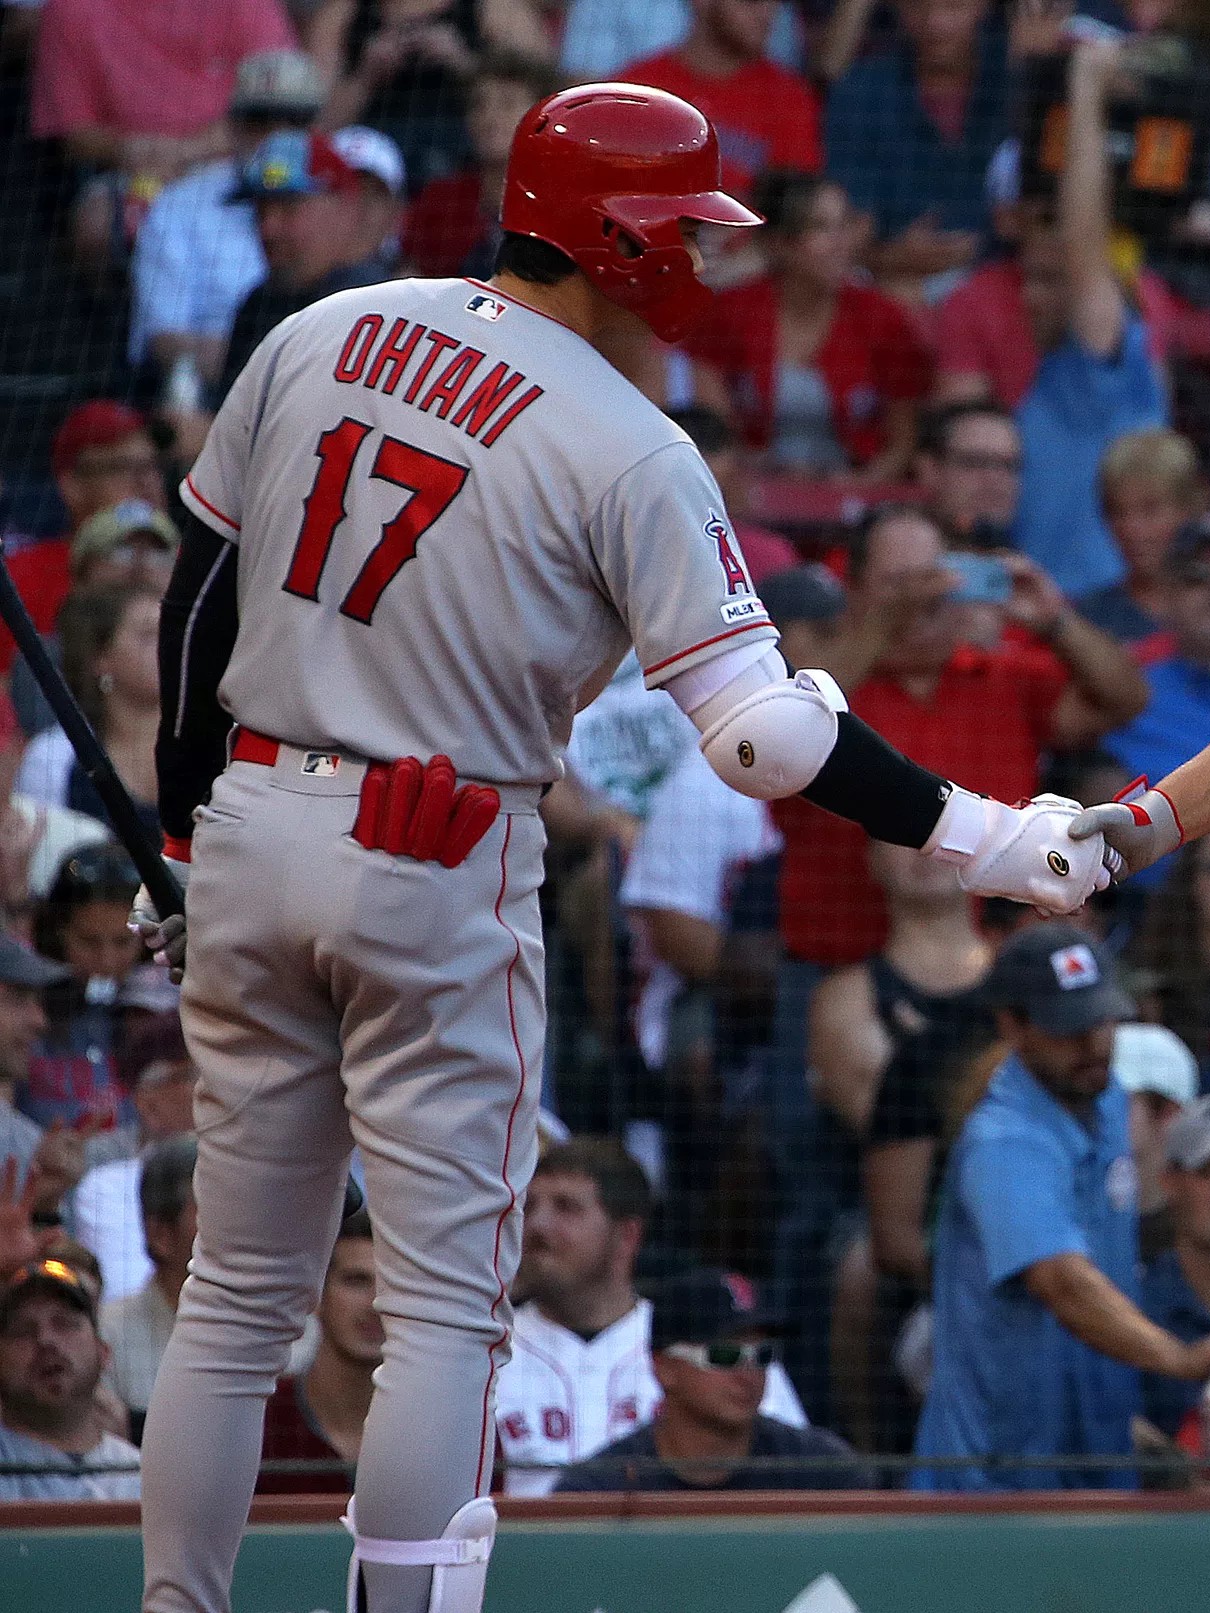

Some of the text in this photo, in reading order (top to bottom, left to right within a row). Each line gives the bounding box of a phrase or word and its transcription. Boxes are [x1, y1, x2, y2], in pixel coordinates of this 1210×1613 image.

[333, 313, 545, 448] OHTANI
[281, 416, 471, 626] 17
[704, 508, 752, 596] A
